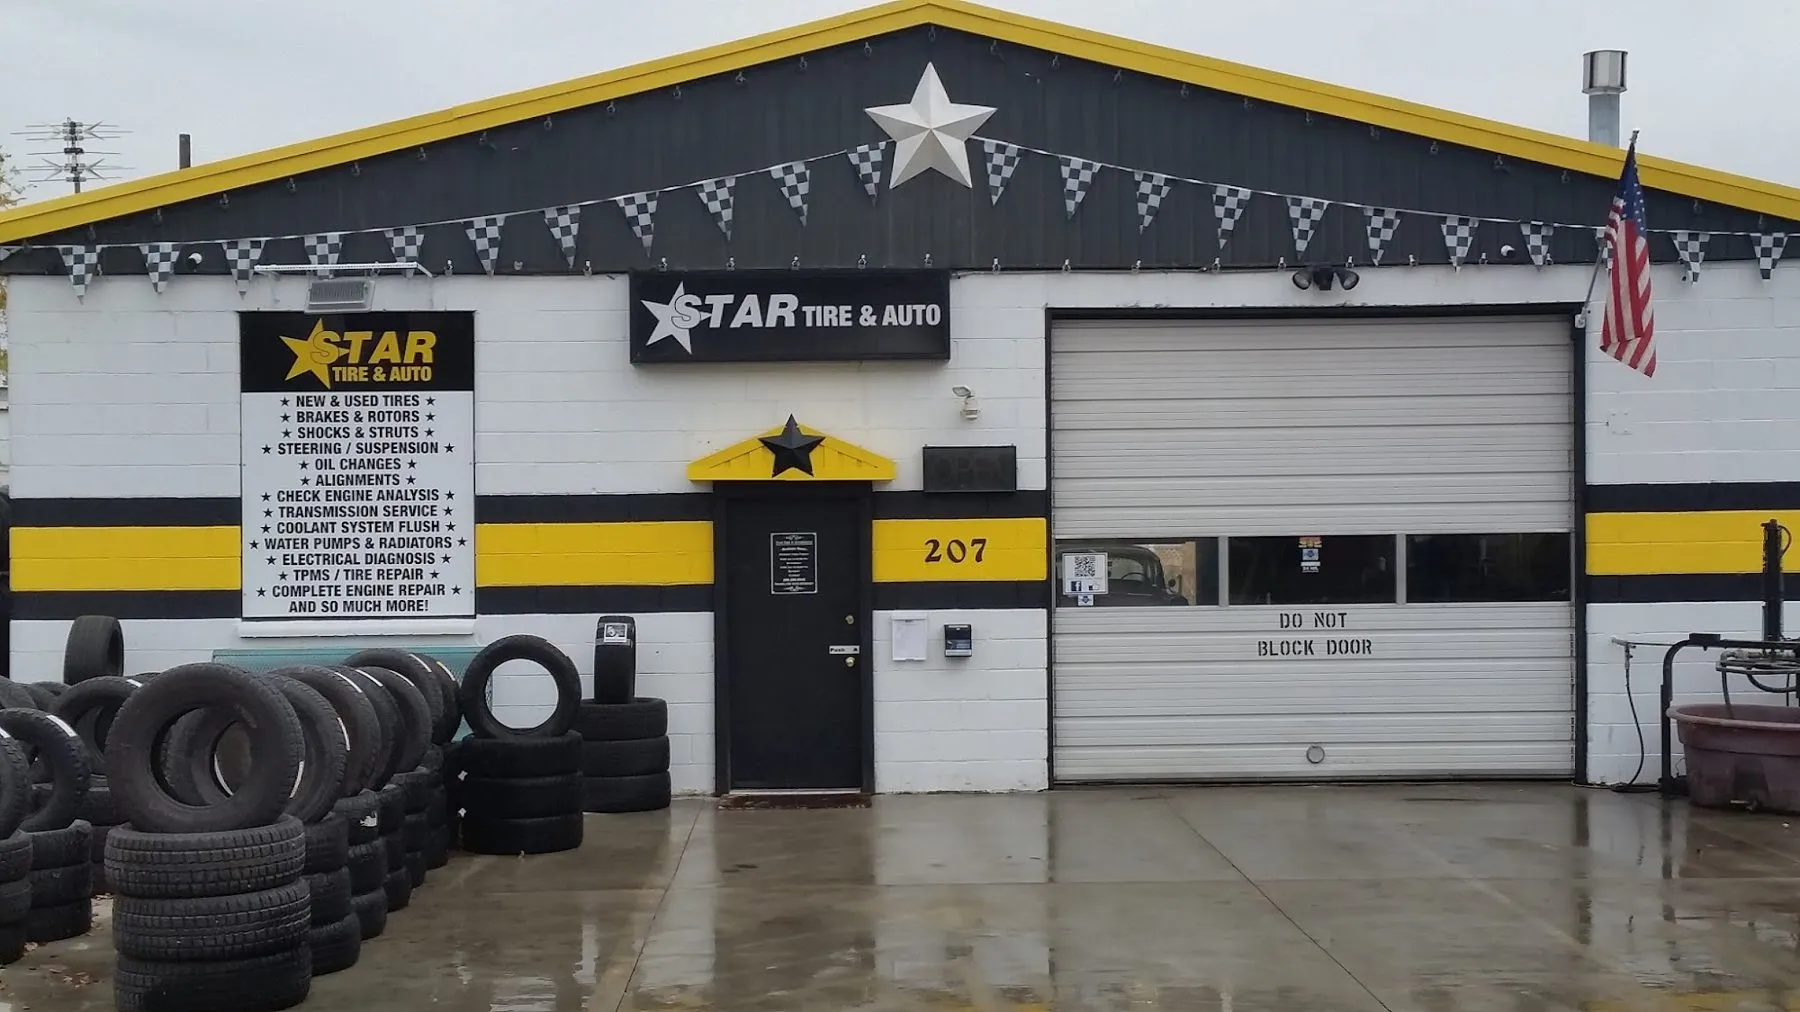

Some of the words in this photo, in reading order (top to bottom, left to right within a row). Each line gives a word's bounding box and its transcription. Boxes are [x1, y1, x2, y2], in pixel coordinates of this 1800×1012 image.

[670, 294, 798, 329] STAR
[802, 306, 852, 327] TIRE
[859, 305, 877, 326] &
[882, 304, 941, 326] AUTO
[310, 330, 437, 364] STAR
[332, 367, 368, 382] TIRE
[373, 368, 386, 381] &
[390, 367, 432, 381] AUTO
[296, 396, 325, 407] NEW
[331, 396, 340, 407] &
[345, 396, 378, 407] USED
[383, 395, 420, 407] TIRES
[297, 411, 349, 423] BRAKES
[354, 412, 363, 423] &
[368, 411, 420, 422] ROTORS
[297, 427, 350, 439] SHOCKS
[355, 427, 364, 438] &
[369, 427, 418, 438] STRUTS
[278, 443, 341, 455] STEERING
[346, 443, 351, 454] /
[356, 442, 438, 454] SUSPENSION
[315, 458, 336, 470] OIL
[340, 458, 401, 470] CHANGES
[315, 474, 400, 486] ALIGNMENTS
[277, 490, 321, 502] CHECK
[326, 490, 374, 501] ENGINE
[377, 489, 439, 501] ANALYSIS
[279, 506, 379, 518] TRANSMISSION
[383, 505, 437, 517] SERVICE
[277, 522, 337, 534] COOLANT
[341, 521, 394, 533] SYSTEM
[399, 521, 439, 532] FLUSH
[265, 538, 309, 550] WATER
[314, 538, 360, 549] PUMPS
[365, 537, 374, 548] &
[379, 537, 452, 548] RADIATORS
[924, 538, 987, 563] 207
[283, 553, 360, 565] ELECTRICAL
[365, 553, 435, 564] DIAGNOSIS
[294, 569, 330, 581] TPMS
[334, 569, 340, 581] /
[344, 569, 373, 580] TIRE
[377, 568, 423, 580] REPAIR
[272, 585, 341, 597] COMPLETE
[346, 584, 395, 596] ENGINE
[399, 584, 445, 596] REPAIR
[289, 601, 316, 612] AND
[321, 601, 338, 612] SO
[343, 600, 381, 612] MUCH
[386, 600, 428, 611] MORE!
[1280, 613, 1302, 628] DO
[1314, 612, 1347, 628] NOT
[1258, 640, 1314, 656] BLOCK
[1327, 639, 1372, 655] DOOR
